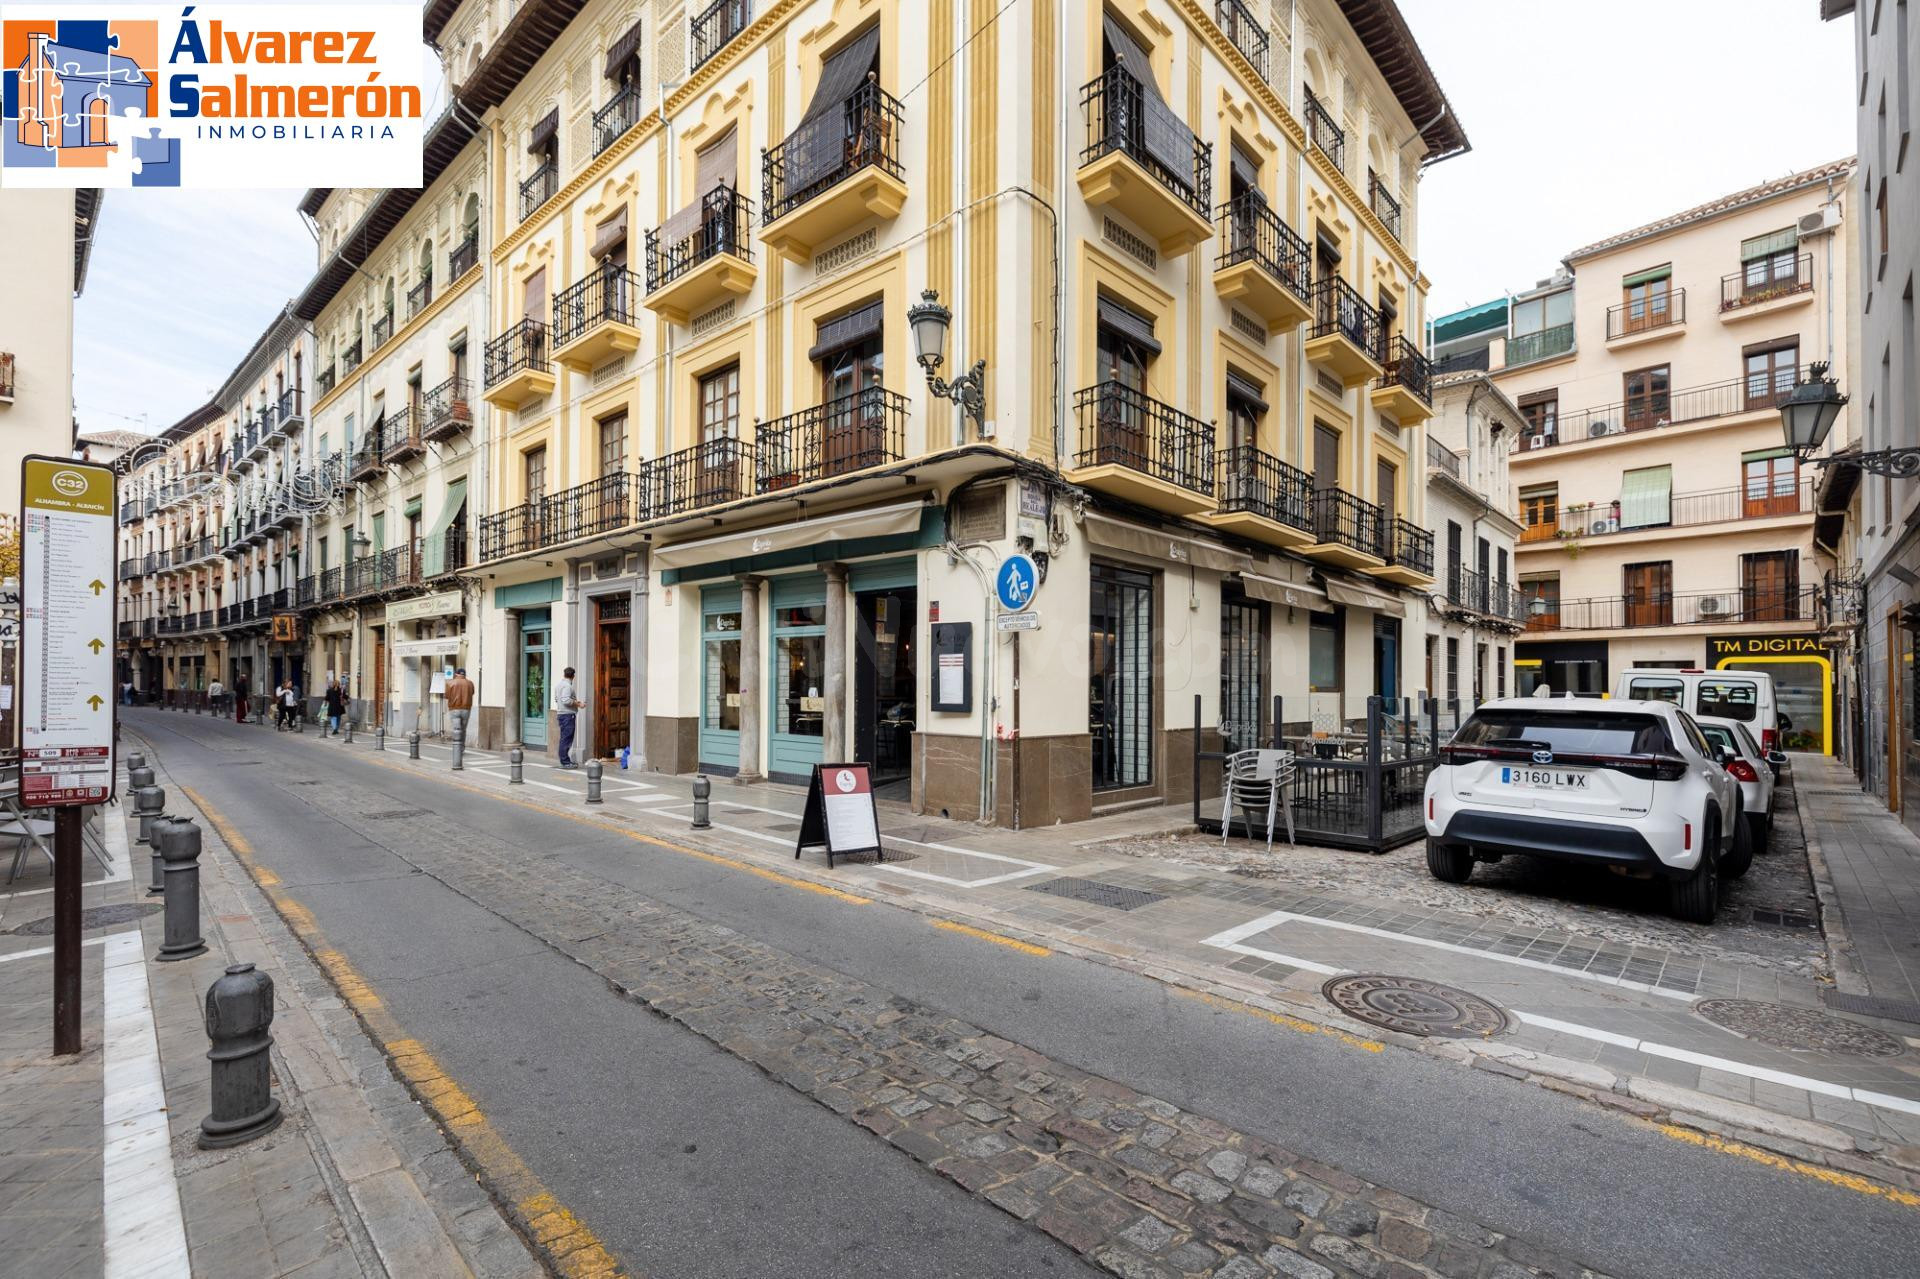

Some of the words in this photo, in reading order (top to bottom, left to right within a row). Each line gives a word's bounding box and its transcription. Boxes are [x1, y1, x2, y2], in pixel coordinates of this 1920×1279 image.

[57, 478, 84, 489] C32
[35, 498, 71, 507] ALHAMBRA
[1713, 640, 1742, 653] TM
[1748, 638, 1830, 652] DIGITAL
[1512, 770, 1551, 784] 3160
[1555, 773, 1585, 787] LWX
